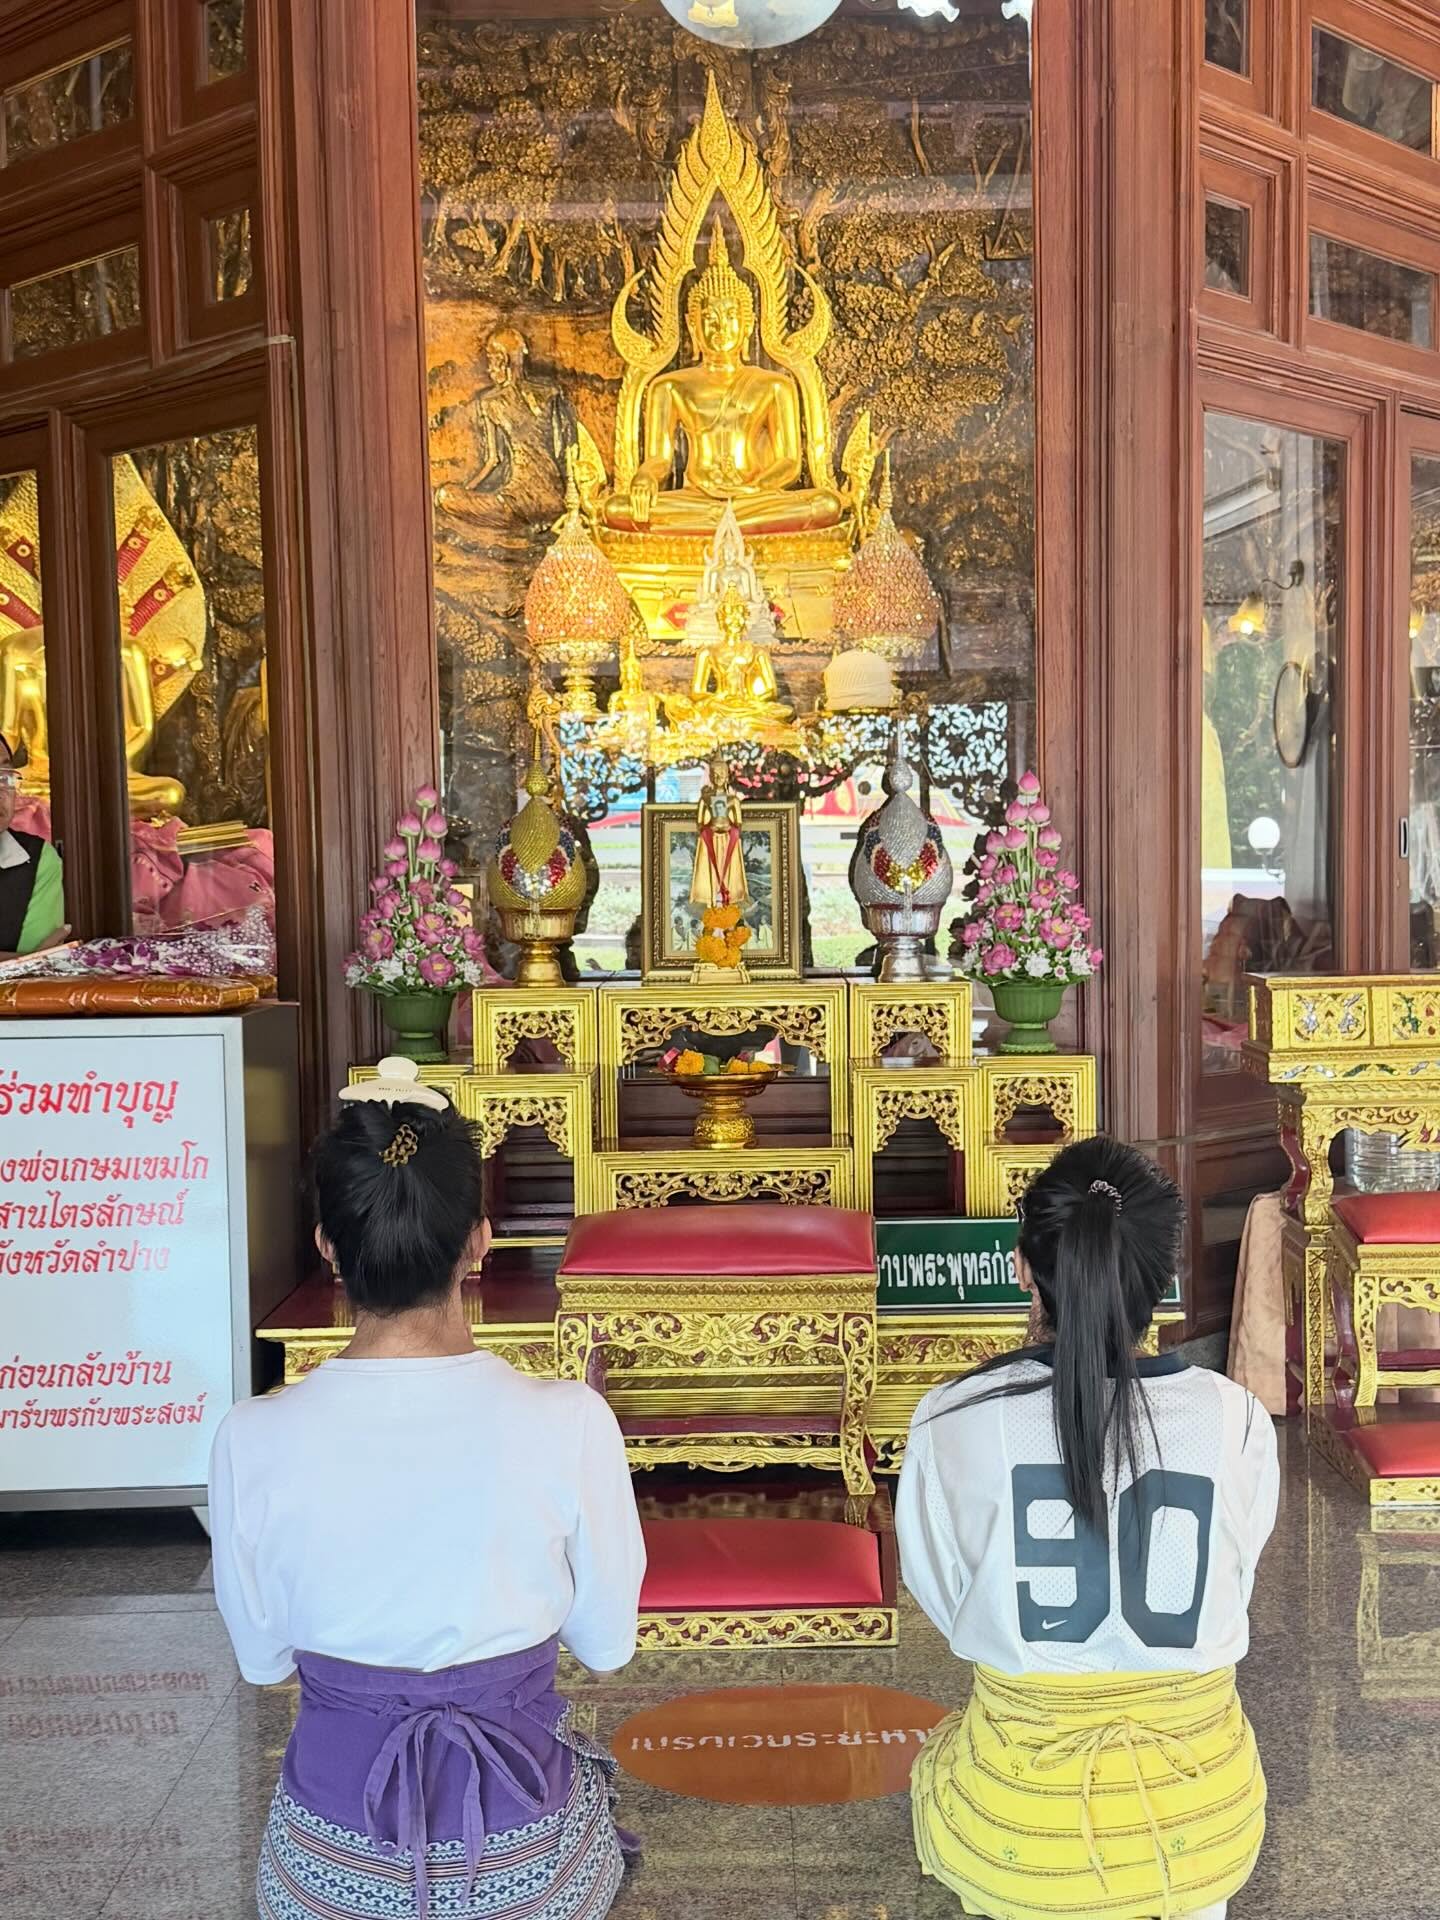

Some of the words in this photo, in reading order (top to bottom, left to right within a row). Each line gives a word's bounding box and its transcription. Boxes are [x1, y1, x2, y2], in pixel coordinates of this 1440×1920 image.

[0, 1239, 170, 1276] ังหวัดลำปาง
[877, 1240, 1019, 1300] าบพระพุทธก่อ
[0, 1351, 172, 1389] ก่อนกลับบ้าน
[1011, 1463, 1215, 1649] 90
